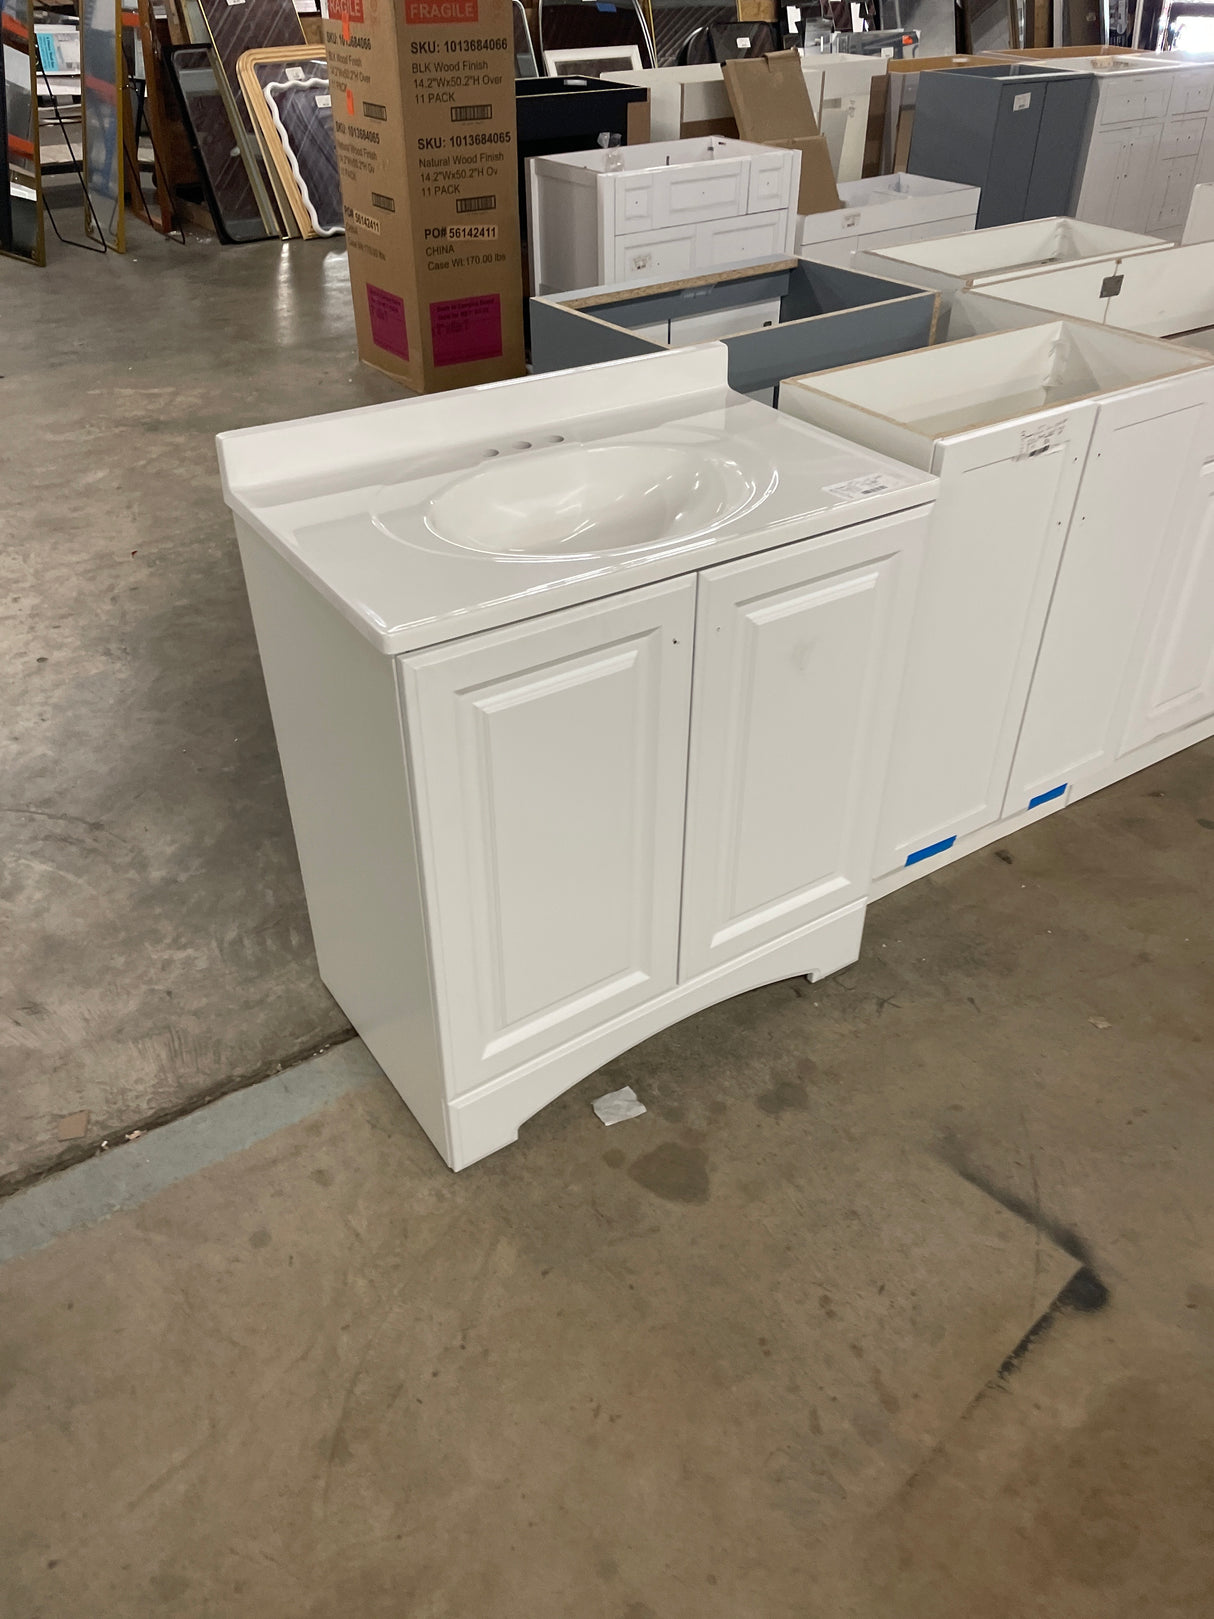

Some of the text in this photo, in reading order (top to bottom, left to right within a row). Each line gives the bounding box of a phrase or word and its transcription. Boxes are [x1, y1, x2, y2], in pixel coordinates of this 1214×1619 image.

[410, 2, 474, 18] FRAGILE
[410, 38, 507, 54] SKU: 1013684066
[412, 60, 488, 73] BLK Wood Finish
[482, 74, 502, 85] Over
[416, 92, 455, 104] 11 PACK
[418, 132, 511, 149] SKU: 1013684065
[419, 152, 504, 168] Natural Wood Finish
[486, 166, 498, 176] Ov
[422, 184, 460, 196] 11 PACK
[424, 227, 496, 239] PO# 56142411
[426, 245, 455, 257] CHINA
[428, 259, 449, 271] Case
[494, 252, 506, 262] lbs
